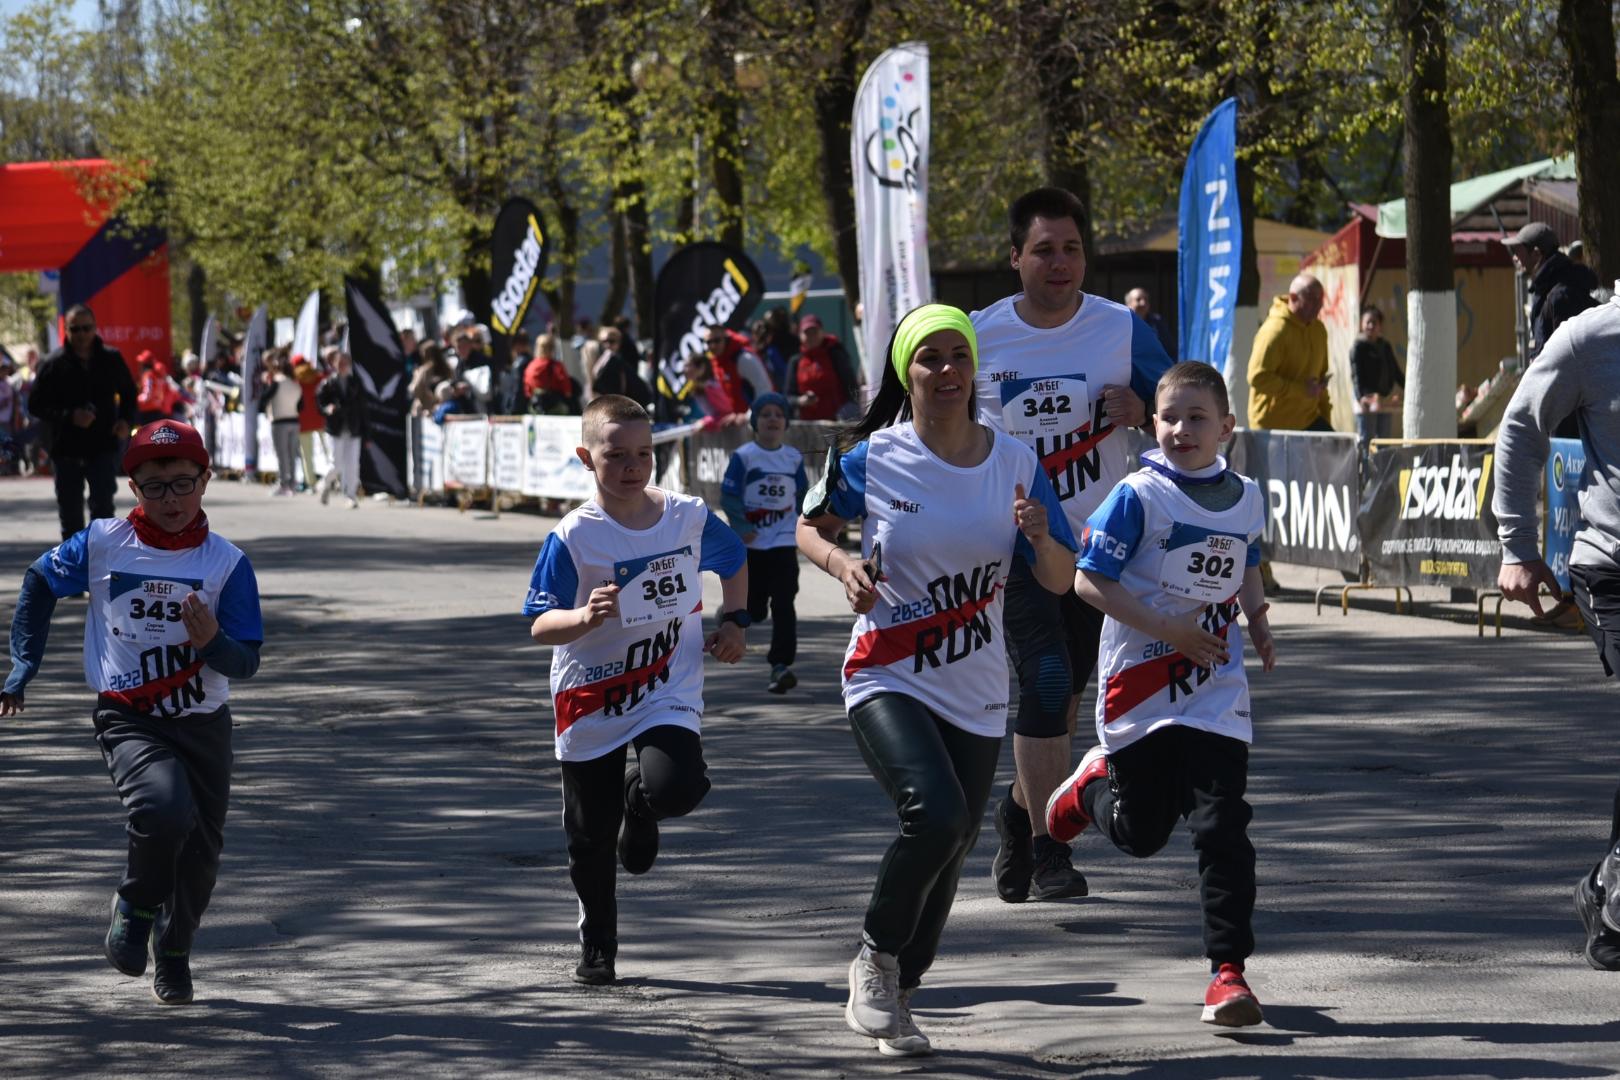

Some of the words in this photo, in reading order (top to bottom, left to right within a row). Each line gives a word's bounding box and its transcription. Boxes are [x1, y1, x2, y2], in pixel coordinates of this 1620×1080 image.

[1023, 395, 1072, 417] 342
[1051, 446, 1101, 503] UN
[758, 484, 786, 496] 265
[1263, 480, 1352, 553] RMIN
[1091, 529, 1128, 561] ПСБ
[1188, 552, 1235, 579] 302
[642, 573, 687, 601] 361
[130, 598, 182, 622] 343
[892, 597, 934, 623] 2022
[913, 608, 992, 673] RUN
[585, 661, 624, 682] 2022
